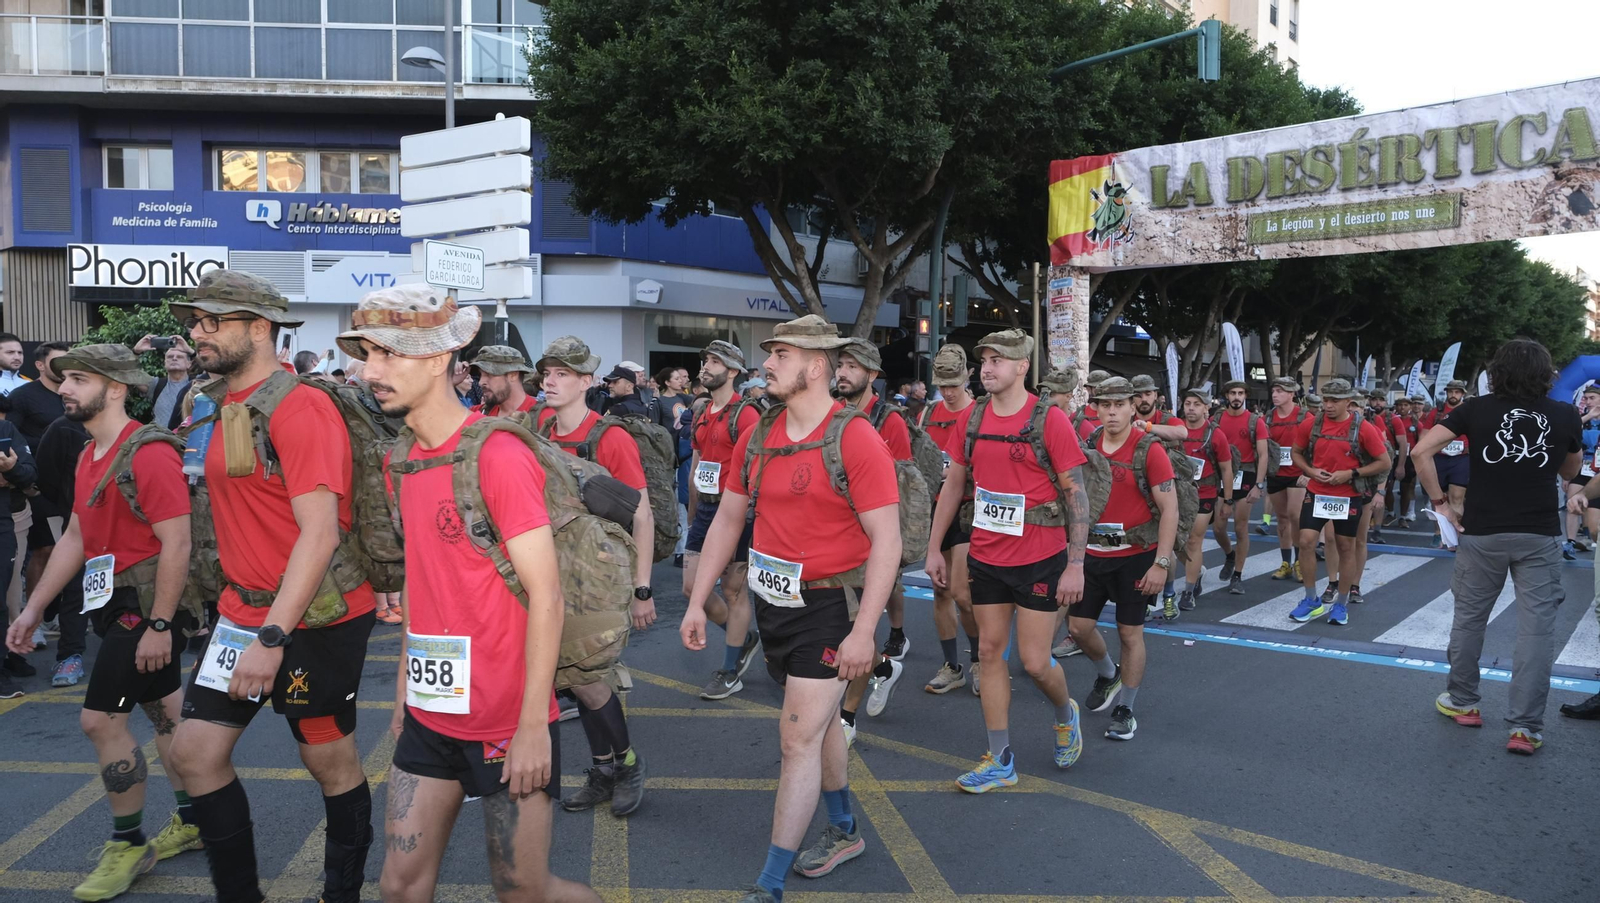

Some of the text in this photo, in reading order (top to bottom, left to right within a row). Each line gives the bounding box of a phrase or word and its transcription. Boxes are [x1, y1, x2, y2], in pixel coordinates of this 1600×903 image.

[1150, 106, 1600, 208] LA DESÉRTICA
[138, 202, 193, 215] Psicología
[287, 200, 401, 224] Háblame
[112, 216, 161, 228] Medicina
[163, 217, 177, 228] de
[1266, 206, 1436, 232] La Legión y el desierto nos une
[287, 223, 400, 236] Centro Interdisciplinar
[443, 249, 481, 261] AVENIDA
[438, 259, 472, 273] FEDERICO
[429, 270, 480, 286] GARCÍA LORCA
[698, 470, 715, 483] 4956
[983, 502, 1017, 521] 4977
[1322, 502, 1344, 512] 4960
[757, 569, 792, 595] 4962
